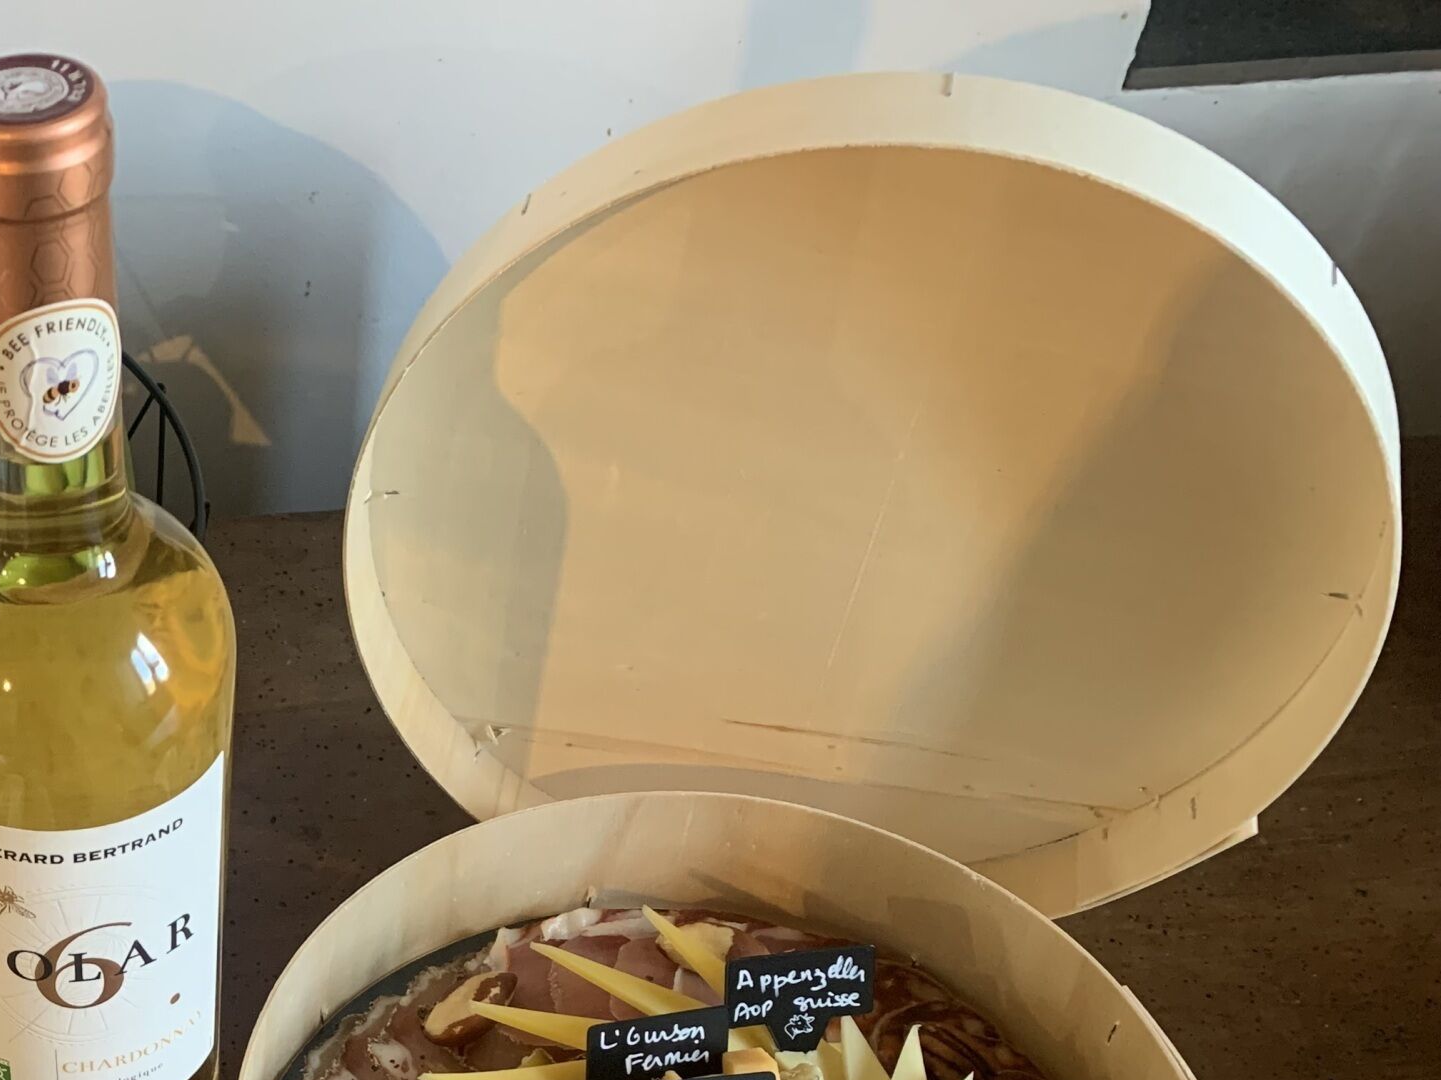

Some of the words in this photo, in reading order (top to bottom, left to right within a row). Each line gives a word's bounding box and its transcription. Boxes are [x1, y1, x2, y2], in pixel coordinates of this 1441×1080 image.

[2, 333, 30, 360] BEE
[0, 400, 58, 447] PROTÉGE
[65, 427, 88, 446] LES
[73, 818, 183, 864] BERTRAND
[35, 921, 132, 1009] 6
